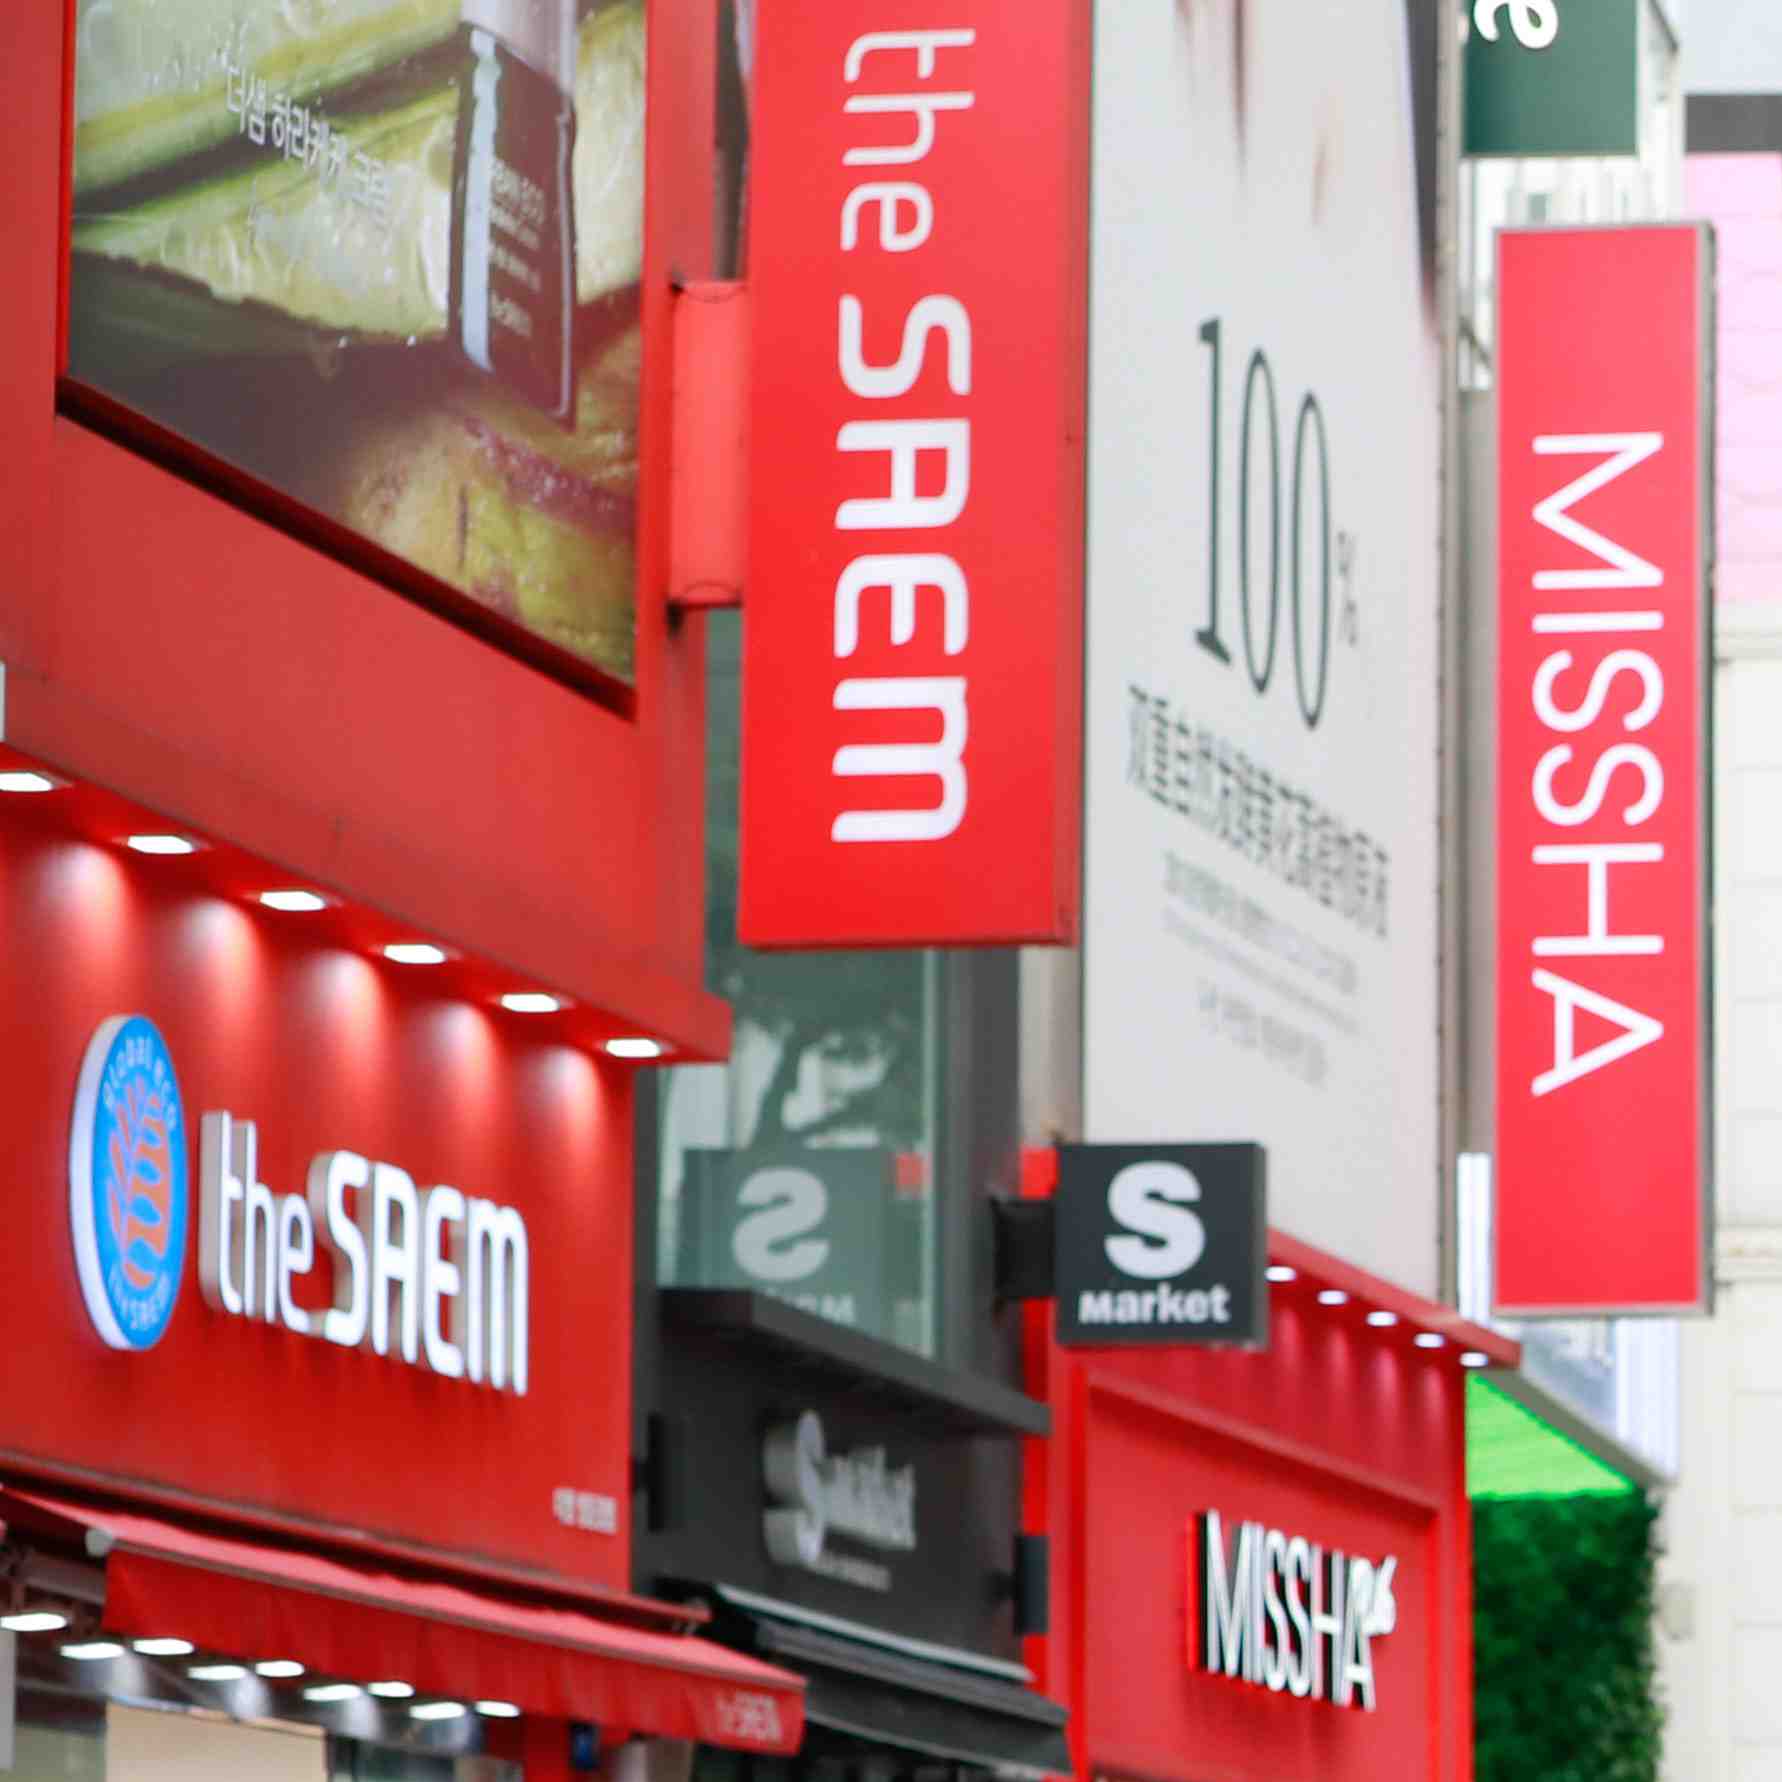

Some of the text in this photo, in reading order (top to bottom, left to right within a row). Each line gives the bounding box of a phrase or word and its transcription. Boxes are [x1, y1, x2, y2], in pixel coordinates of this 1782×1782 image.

[830, 28, 975, 843] the SAEM
[1195, 317, 1331, 732] 100
[1531, 431, 1664, 1097] MISSHA
[202, 1111, 528, 1396] the SAEM
[1104, 1160, 1207, 1280] S
[1206, 1508, 1378, 1712] MISSHA
